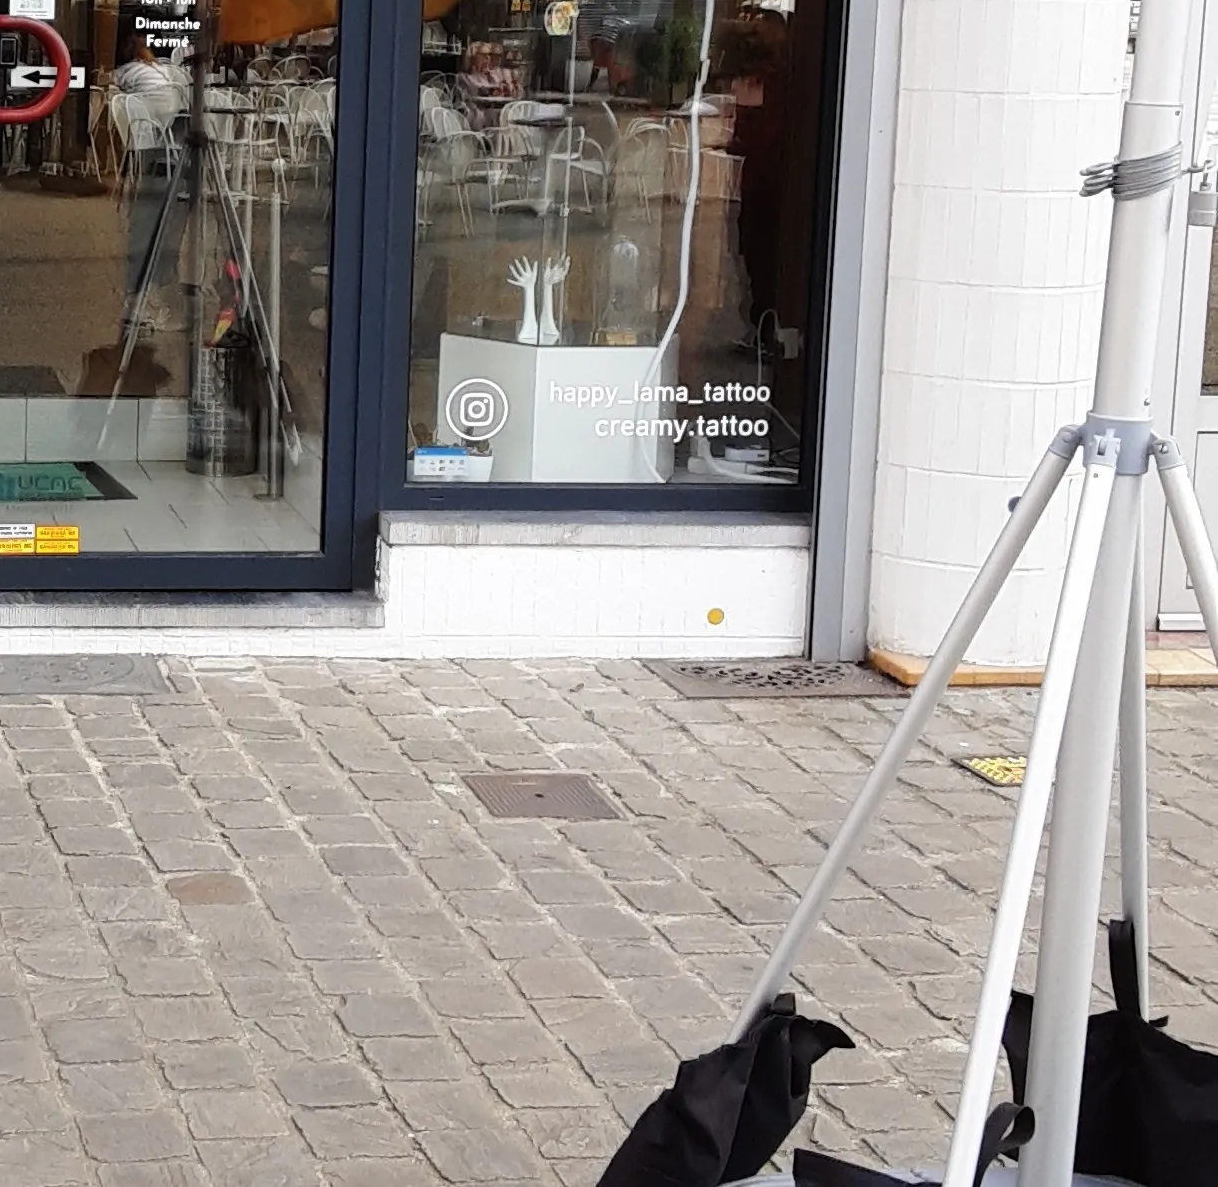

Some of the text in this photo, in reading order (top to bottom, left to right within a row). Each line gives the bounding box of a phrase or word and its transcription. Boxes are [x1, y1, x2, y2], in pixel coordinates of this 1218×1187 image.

[135, 16, 201, 30] Dimanche
[146, 34, 190, 48] Fermé
[549, 380, 771, 409] happy_lama_tattoo
[594, 415, 769, 443] creamy.tattoo
